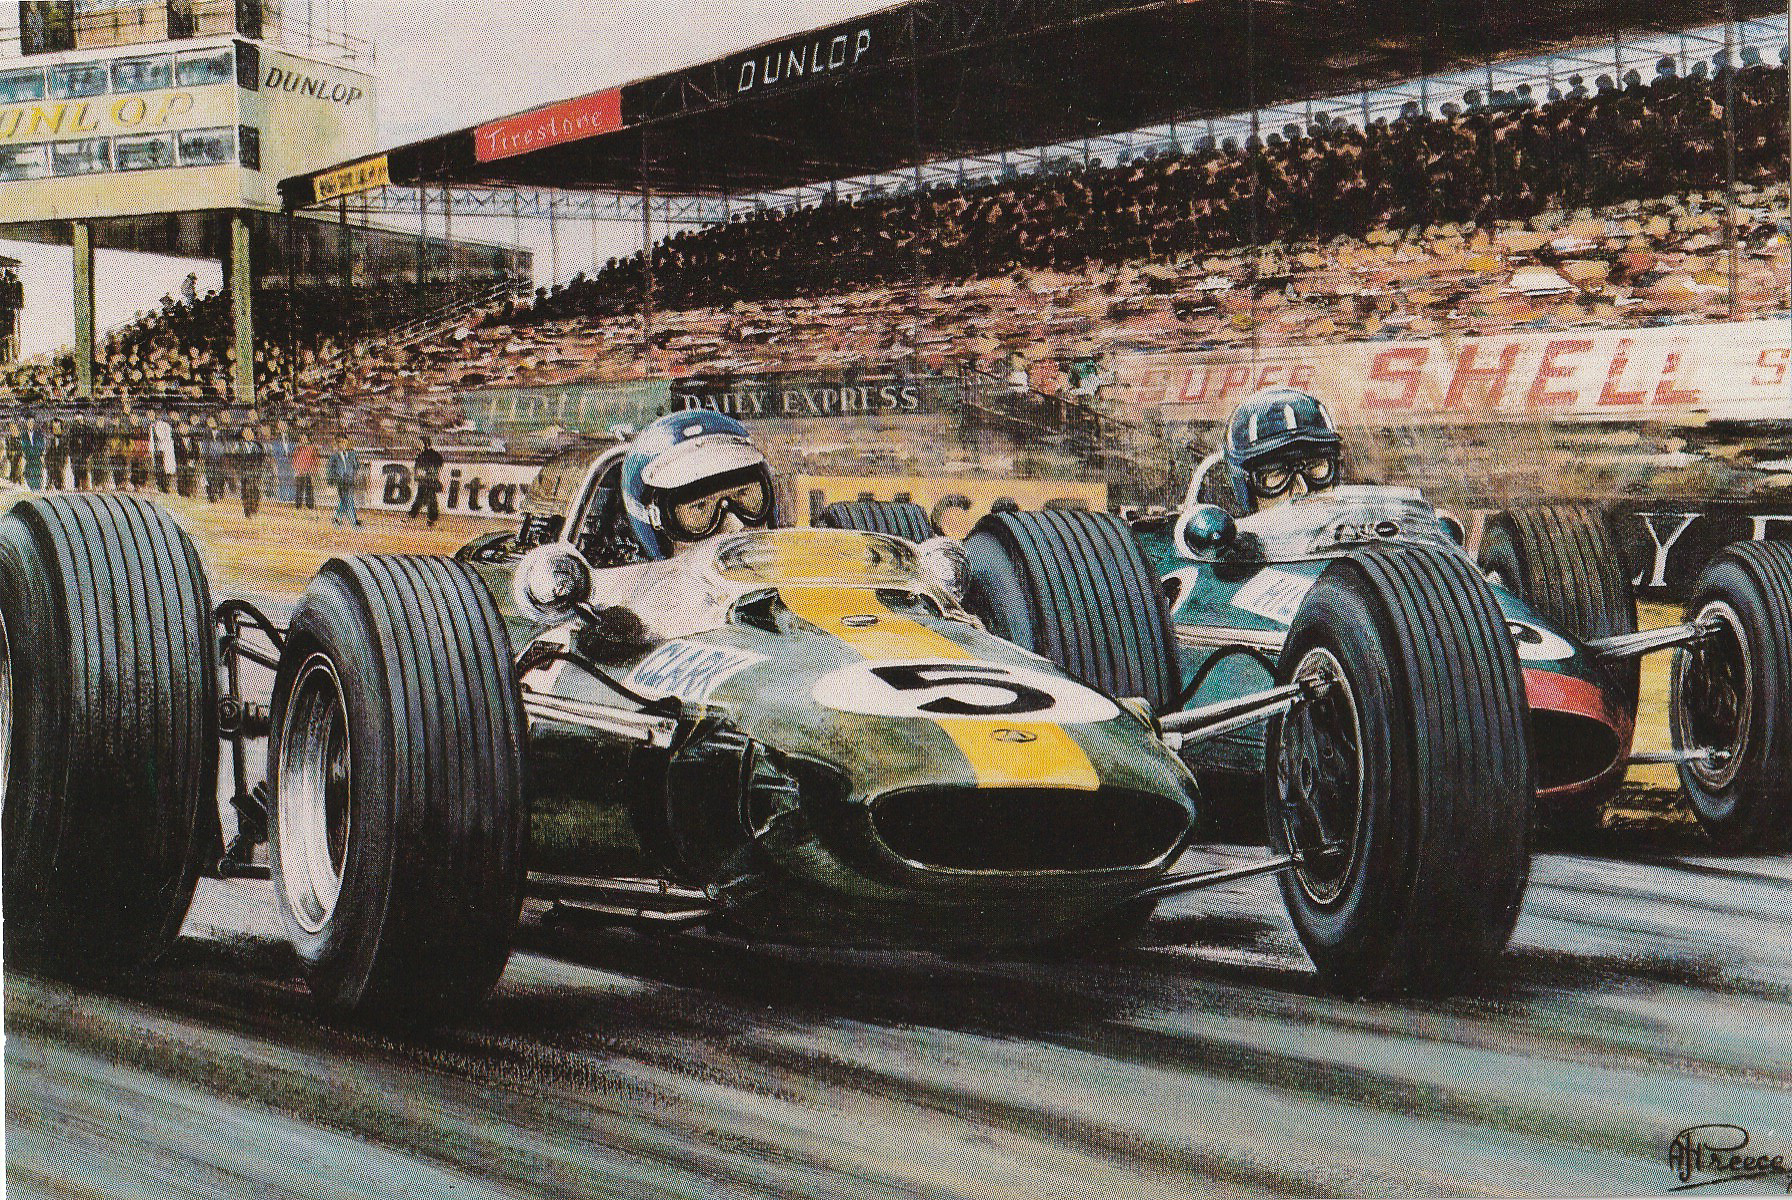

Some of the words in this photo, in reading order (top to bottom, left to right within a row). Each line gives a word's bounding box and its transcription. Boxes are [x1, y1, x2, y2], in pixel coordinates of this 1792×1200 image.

[265, 66, 363, 106] DUNLOP
[738, 29, 871, 92] DUNLOP
[680, 390, 767, 414] DAILY
[783, 384, 918, 415] EXPRESS
[1359, 337, 1702, 411] SHELL
[869, 663, 1057, 715] 5
